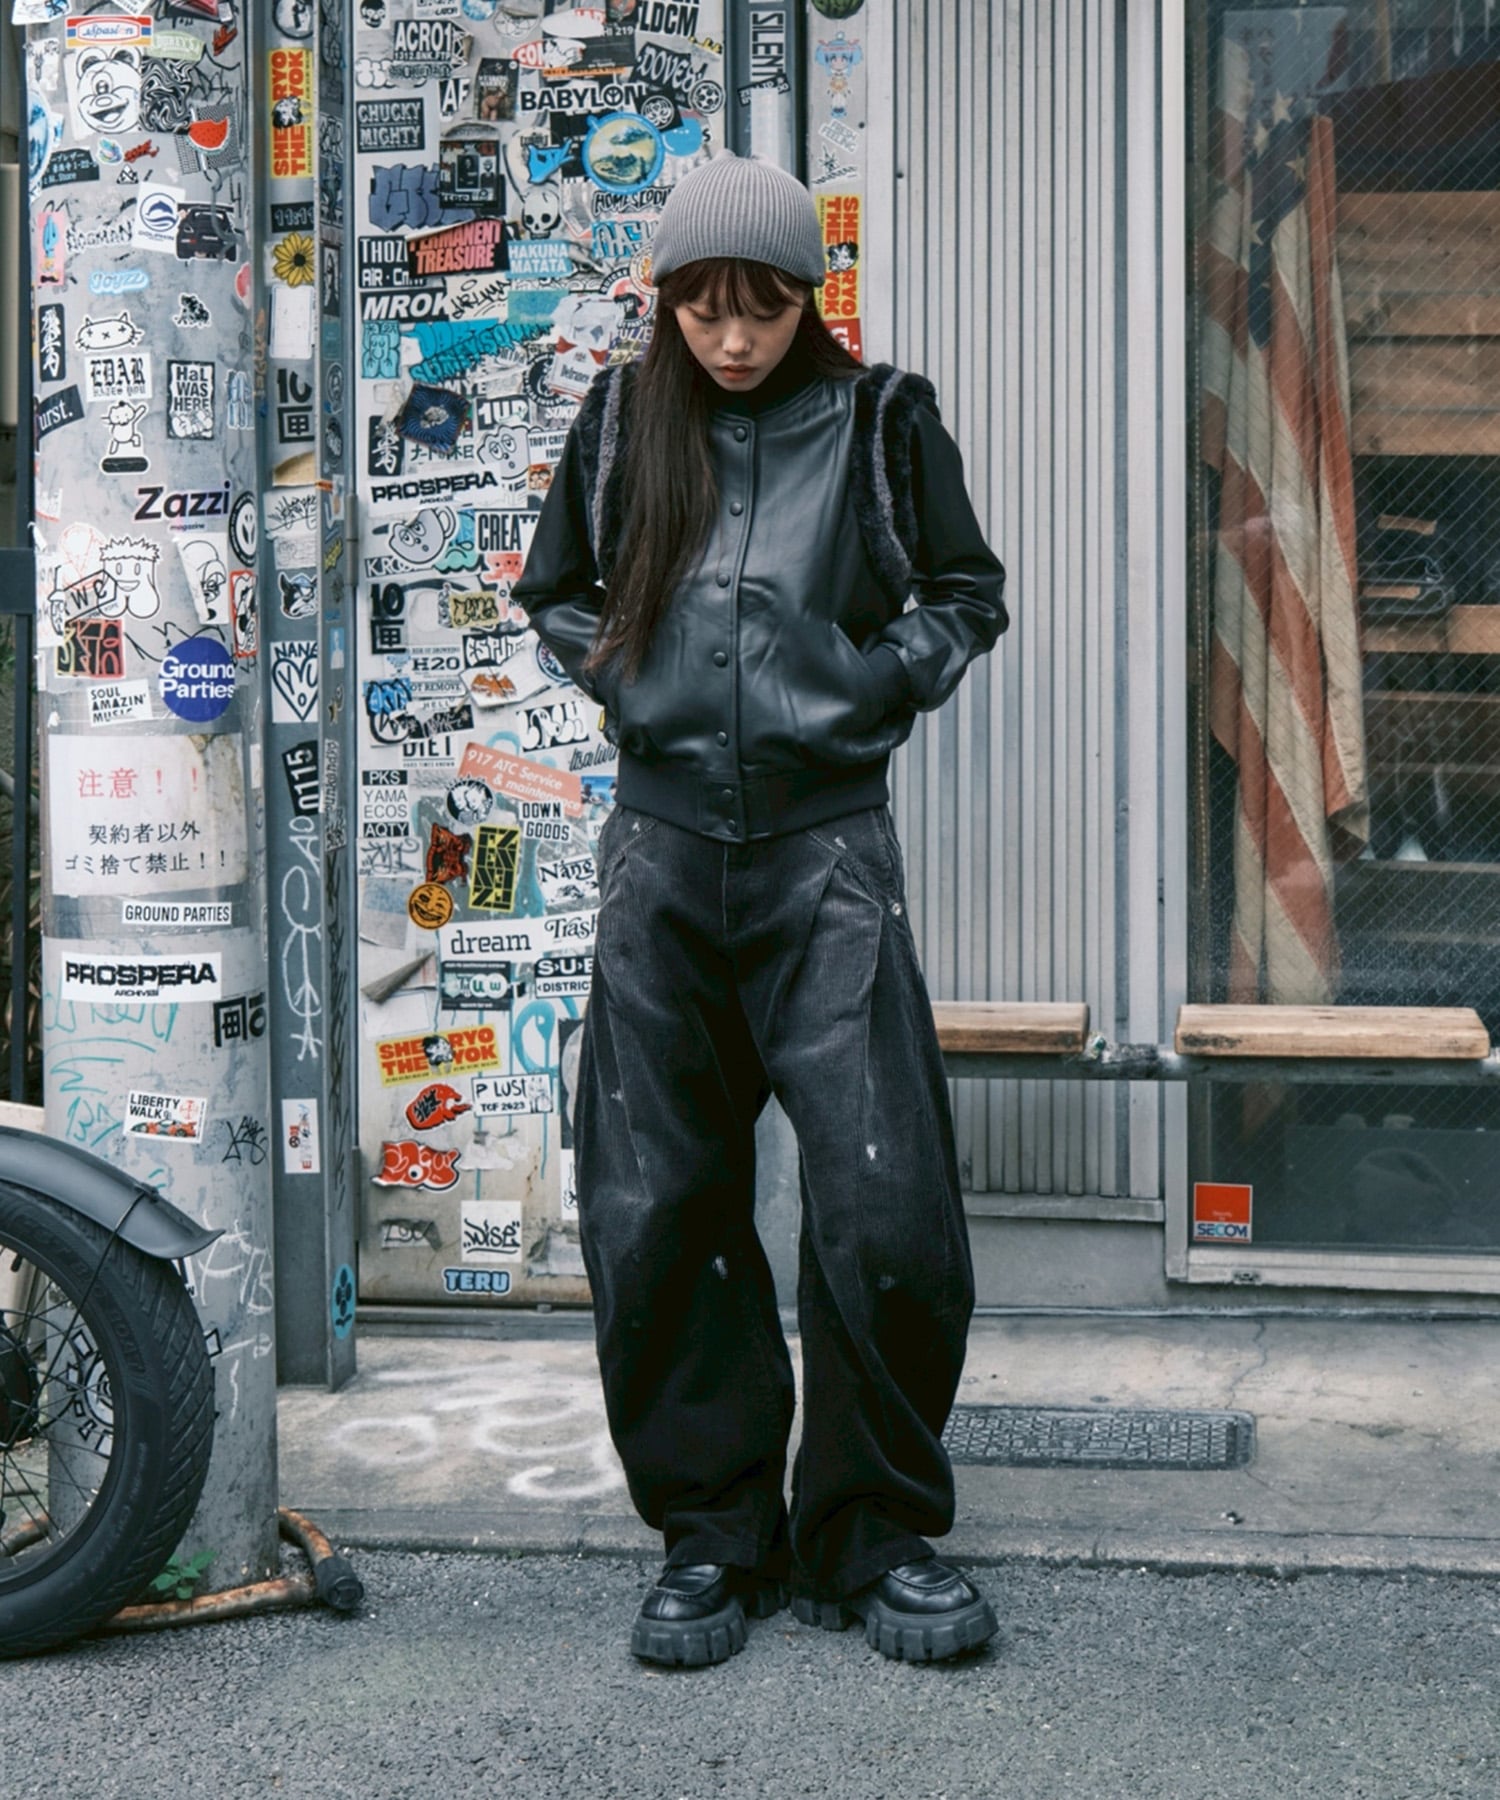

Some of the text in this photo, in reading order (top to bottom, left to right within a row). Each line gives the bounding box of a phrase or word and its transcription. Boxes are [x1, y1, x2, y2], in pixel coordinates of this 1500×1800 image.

[358, 102, 422, 123] CHUCKY
[359, 125, 421, 146] MIGHTY
[416, 244, 495, 275] TREASURE
[509, 244, 569, 260] HAKUNA
[511, 258, 568, 273] MATATA
[176, 382, 209, 397] WAS
[174, 396, 209, 413] HERE
[370, 471, 499, 503] PROSPERA
[134, 480, 231, 521] Zazzi
[371, 583, 405, 617] 10
[91, 686, 120, 700] SOUL
[368, 771, 401, 786] PKS
[468, 750, 563, 791] 917 ATC Service
[493, 773, 504, 786] &
[363, 789, 408, 802] YAMA
[364, 805, 408, 819] ECOS
[522, 803, 562, 819] DOWN
[88, 820, 201, 845] 契約者以外
[364, 823, 408, 838] AQTY
[526, 822, 570, 840] GOODS
[125, 904, 231, 922] GROUND PARTIES
[450, 929, 532, 955] dream
[65, 961, 217, 987] PROSPERA
[379, 1039, 423, 1061] SHE
[382, 1057, 429, 1077] THE
[130, 1094, 181, 1110] LIBERTY
[129, 1106, 162, 1120] WALK
[1197, 1223, 1248, 1238] SECOM
[445, 1269, 510, 1293] TERU
